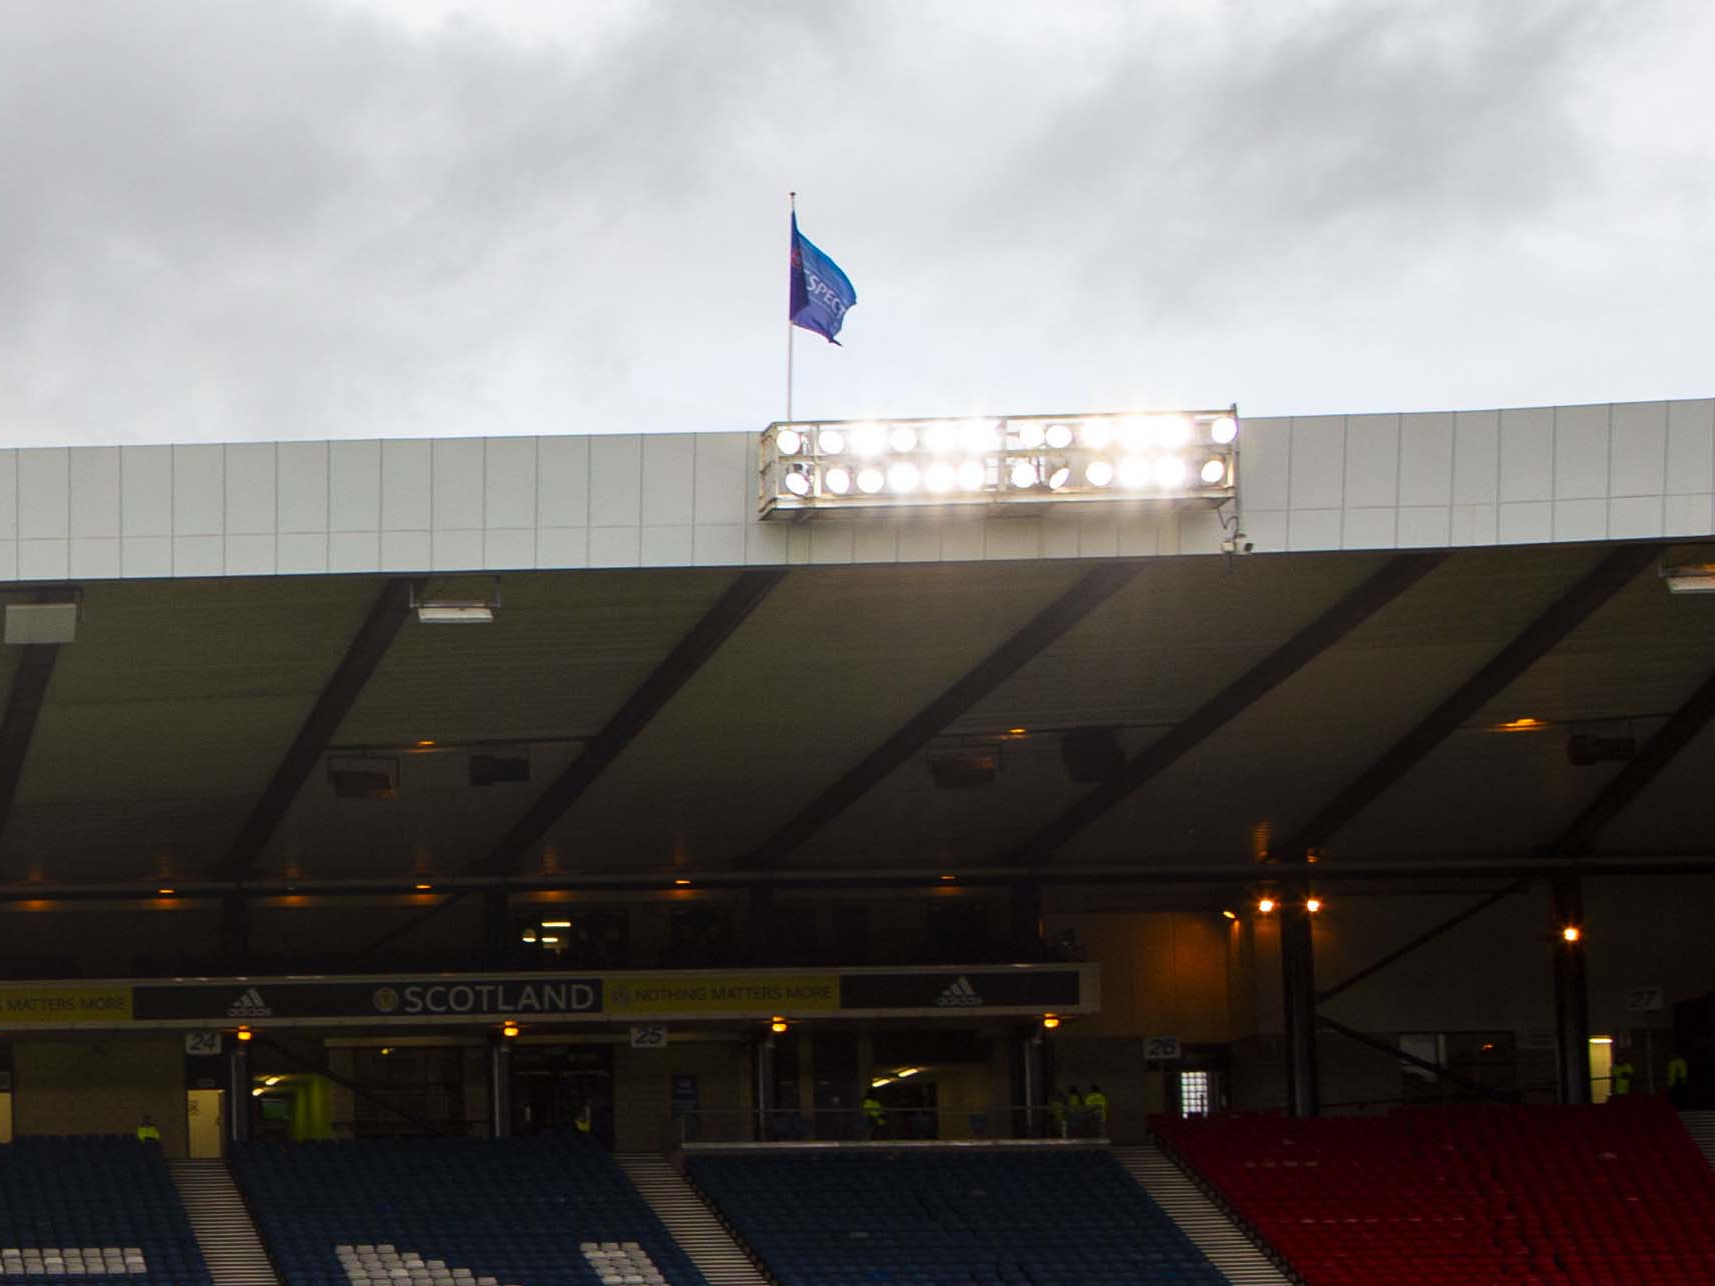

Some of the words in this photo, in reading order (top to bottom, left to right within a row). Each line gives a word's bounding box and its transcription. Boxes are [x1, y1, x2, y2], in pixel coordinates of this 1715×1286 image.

[804, 268, 847, 319] SPECT
[404, 983, 594, 1013] SCOTLAND
[635, 988, 706, 1001] NOTHING
[713, 986, 781, 1000] MATTERS
[787, 986, 832, 999] MORE
[8, 998, 75, 1012] MATTERS
[79, 997, 126, 1010] MORE
[226, 1008, 273, 1017] adidas
[189, 1035, 218, 1051] 24
[635, 1027, 663, 1044] 25
